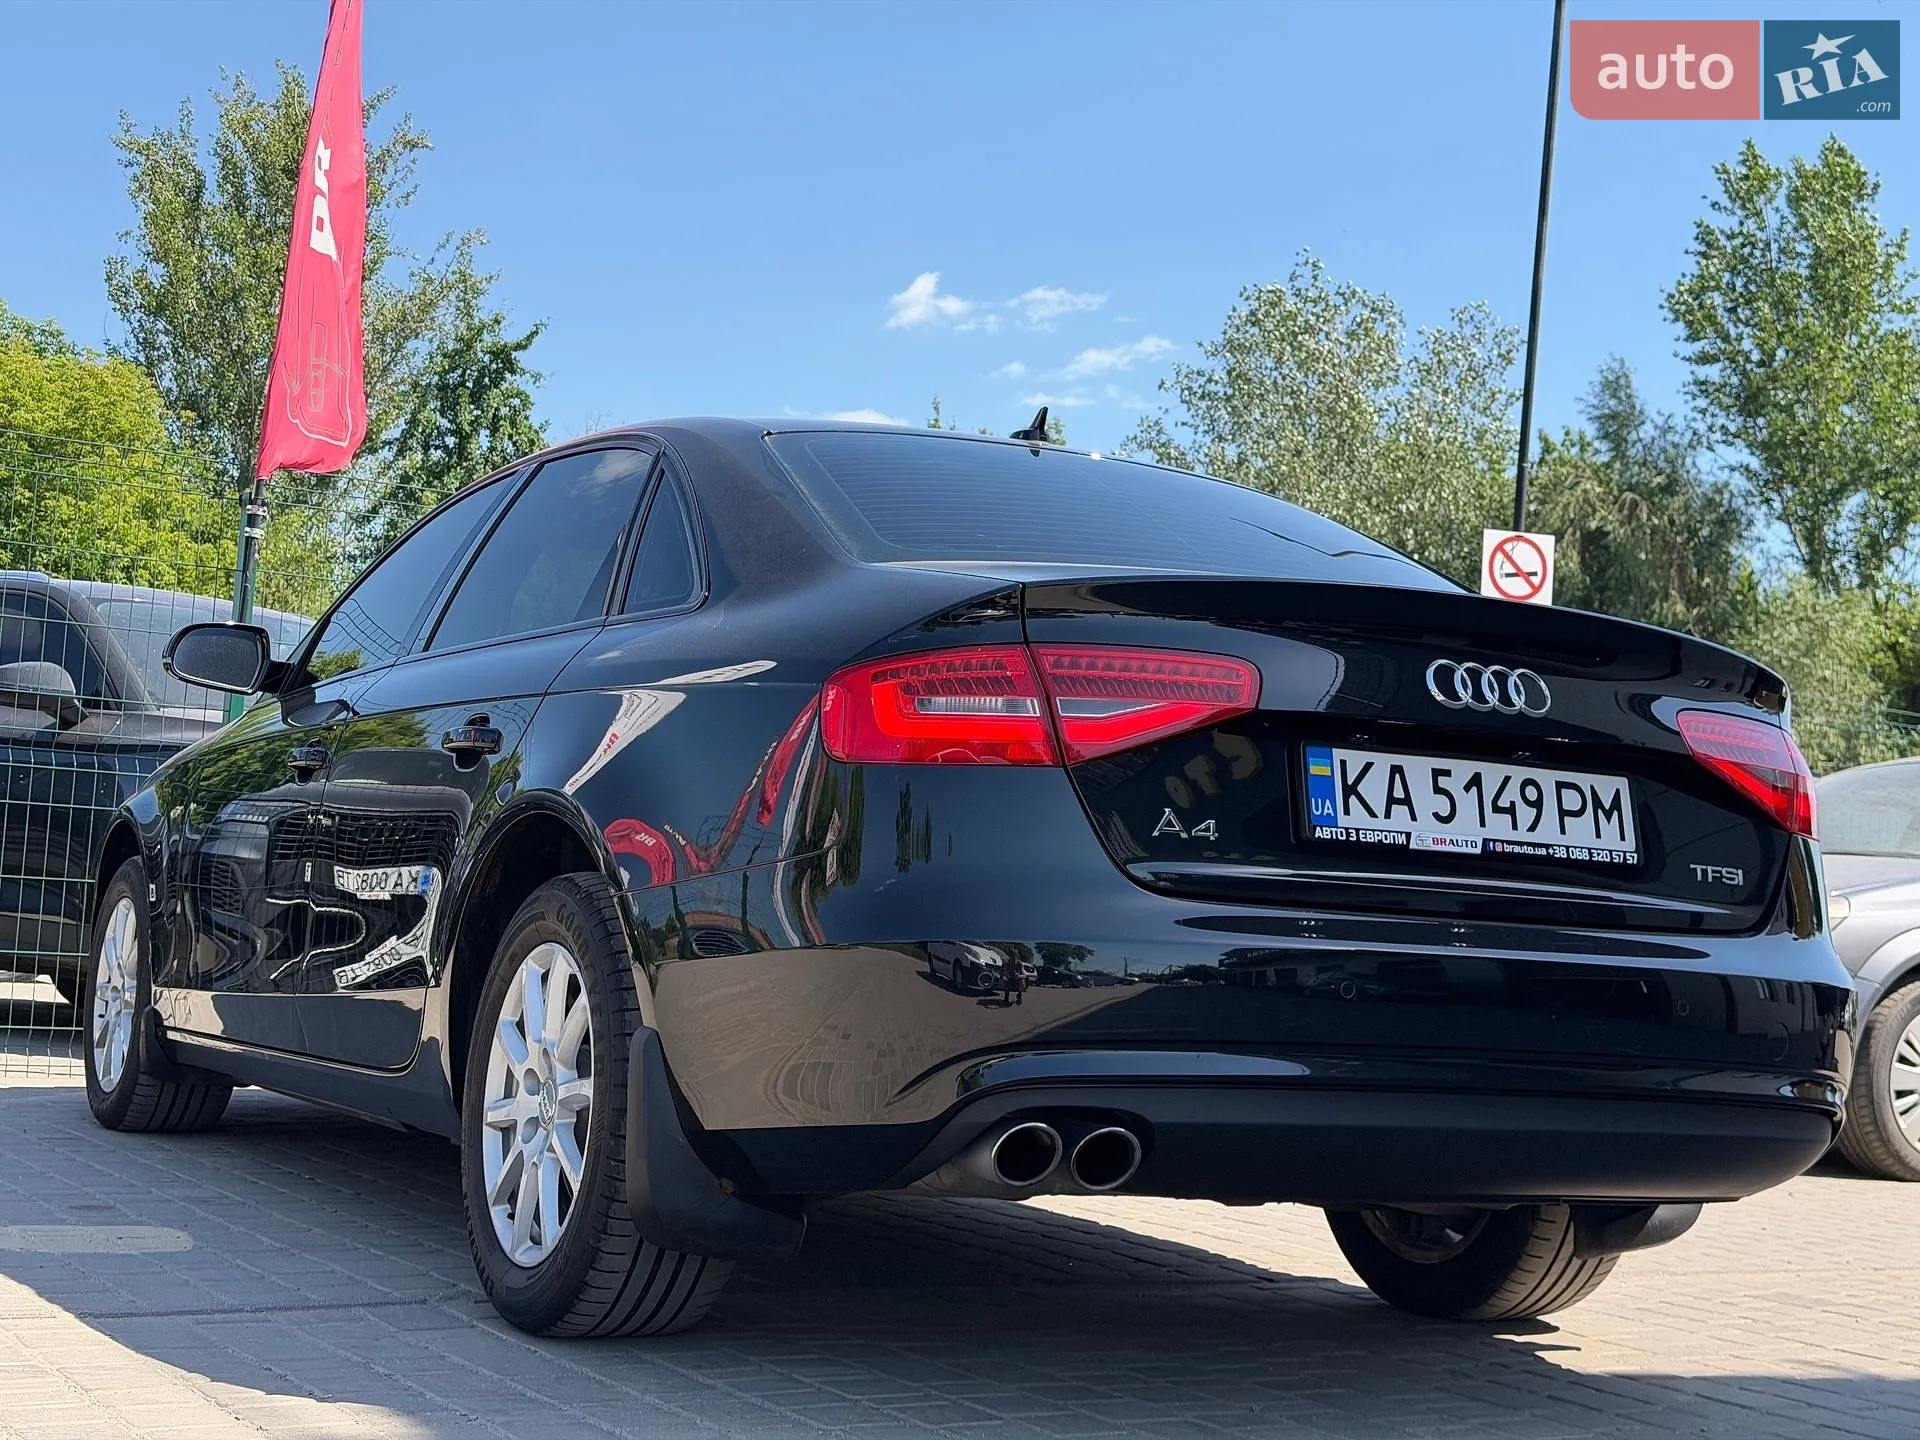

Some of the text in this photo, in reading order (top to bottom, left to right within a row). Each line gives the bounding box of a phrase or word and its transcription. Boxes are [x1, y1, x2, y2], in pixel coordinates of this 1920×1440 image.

[1311, 797, 1335, 817] UA
[1339, 758, 1626, 842] KA 5149 PM
[1152, 807, 1219, 841] A4
[1314, 826, 1346, 841] АВТО
[1431, 836, 1478, 849] BRAUTO
[1503, 844, 1638, 865] brauto.ua +38 068 320 57 57
[1689, 863, 1744, 886] TFSI
